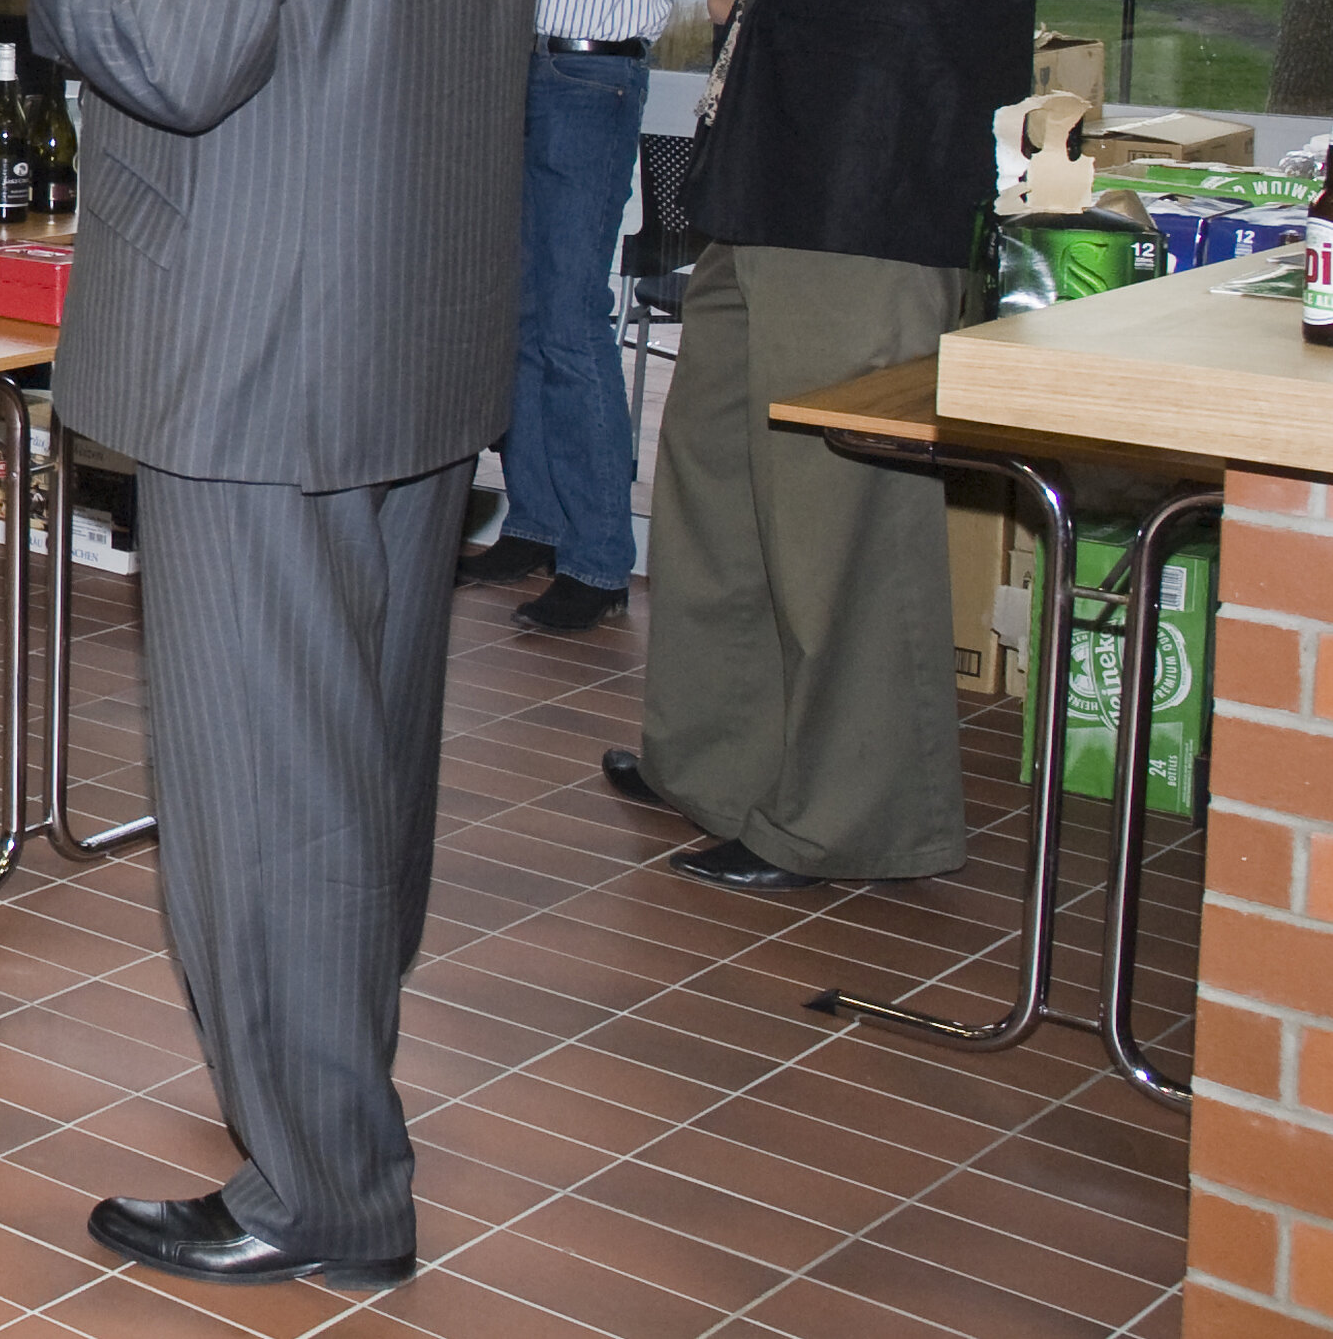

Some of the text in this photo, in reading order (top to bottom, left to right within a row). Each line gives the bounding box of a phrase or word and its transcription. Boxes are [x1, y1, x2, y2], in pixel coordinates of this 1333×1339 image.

[1252, 180, 1325, 205] EMIUM
[1235, 229, 1255, 244] 12
[1131, 242, 1155, 257] 12
[1305, 242, 1332, 290] pi
[1095, 618, 1125, 727] einek
[1148, 758, 1167, 778] 24
[1167, 754, 1178, 787] BOTTLES
